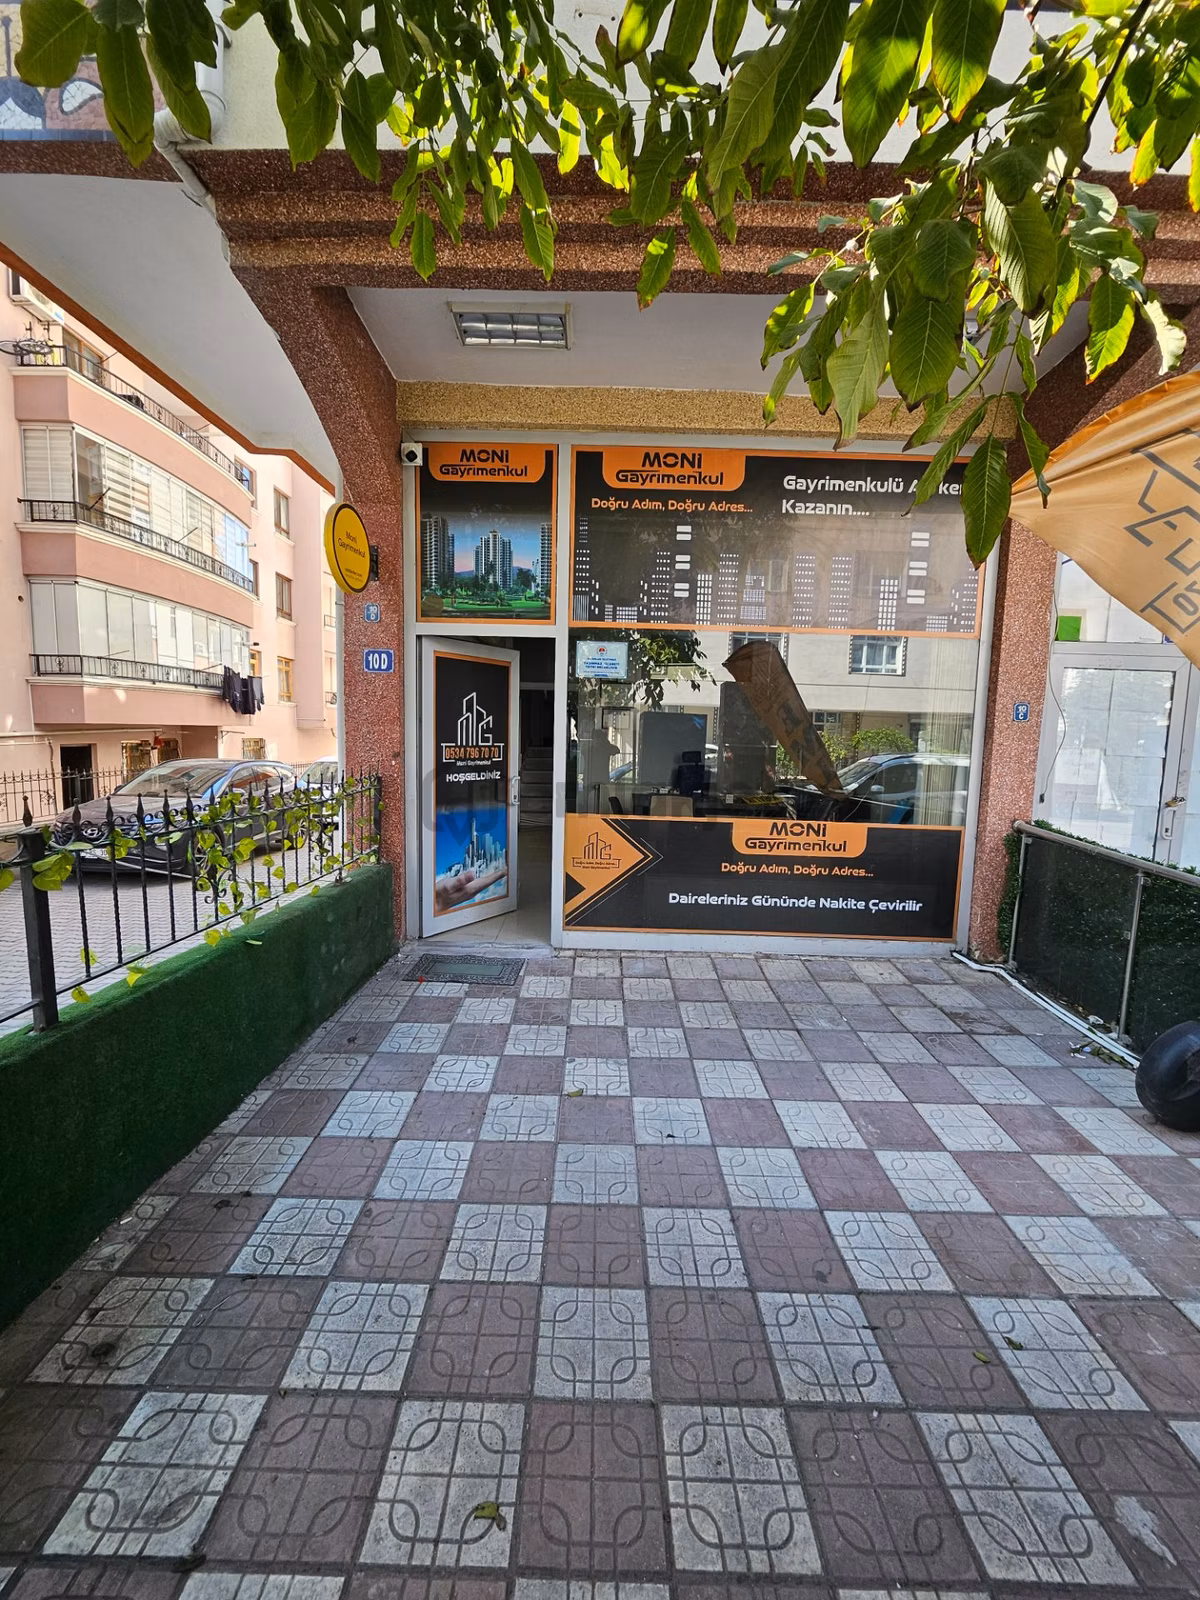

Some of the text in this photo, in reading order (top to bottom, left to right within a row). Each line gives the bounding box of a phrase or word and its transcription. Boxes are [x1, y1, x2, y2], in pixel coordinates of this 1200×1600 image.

[783, 475, 904, 494] Gayrimenkulü
[591, 496, 753, 512] Doğru Adım, Doğru Adres...
[368, 653, 388, 670] 10 D
[445, 747, 499, 759] 0534 796 70 70
[446, 770, 501, 784] HOŞGELDİNİZ
[722, 862, 874, 877] Doğru Adım, Doğru Adres...
[668, 892, 923, 914] Daireleriniz Gününde Nakite Çevirilir
